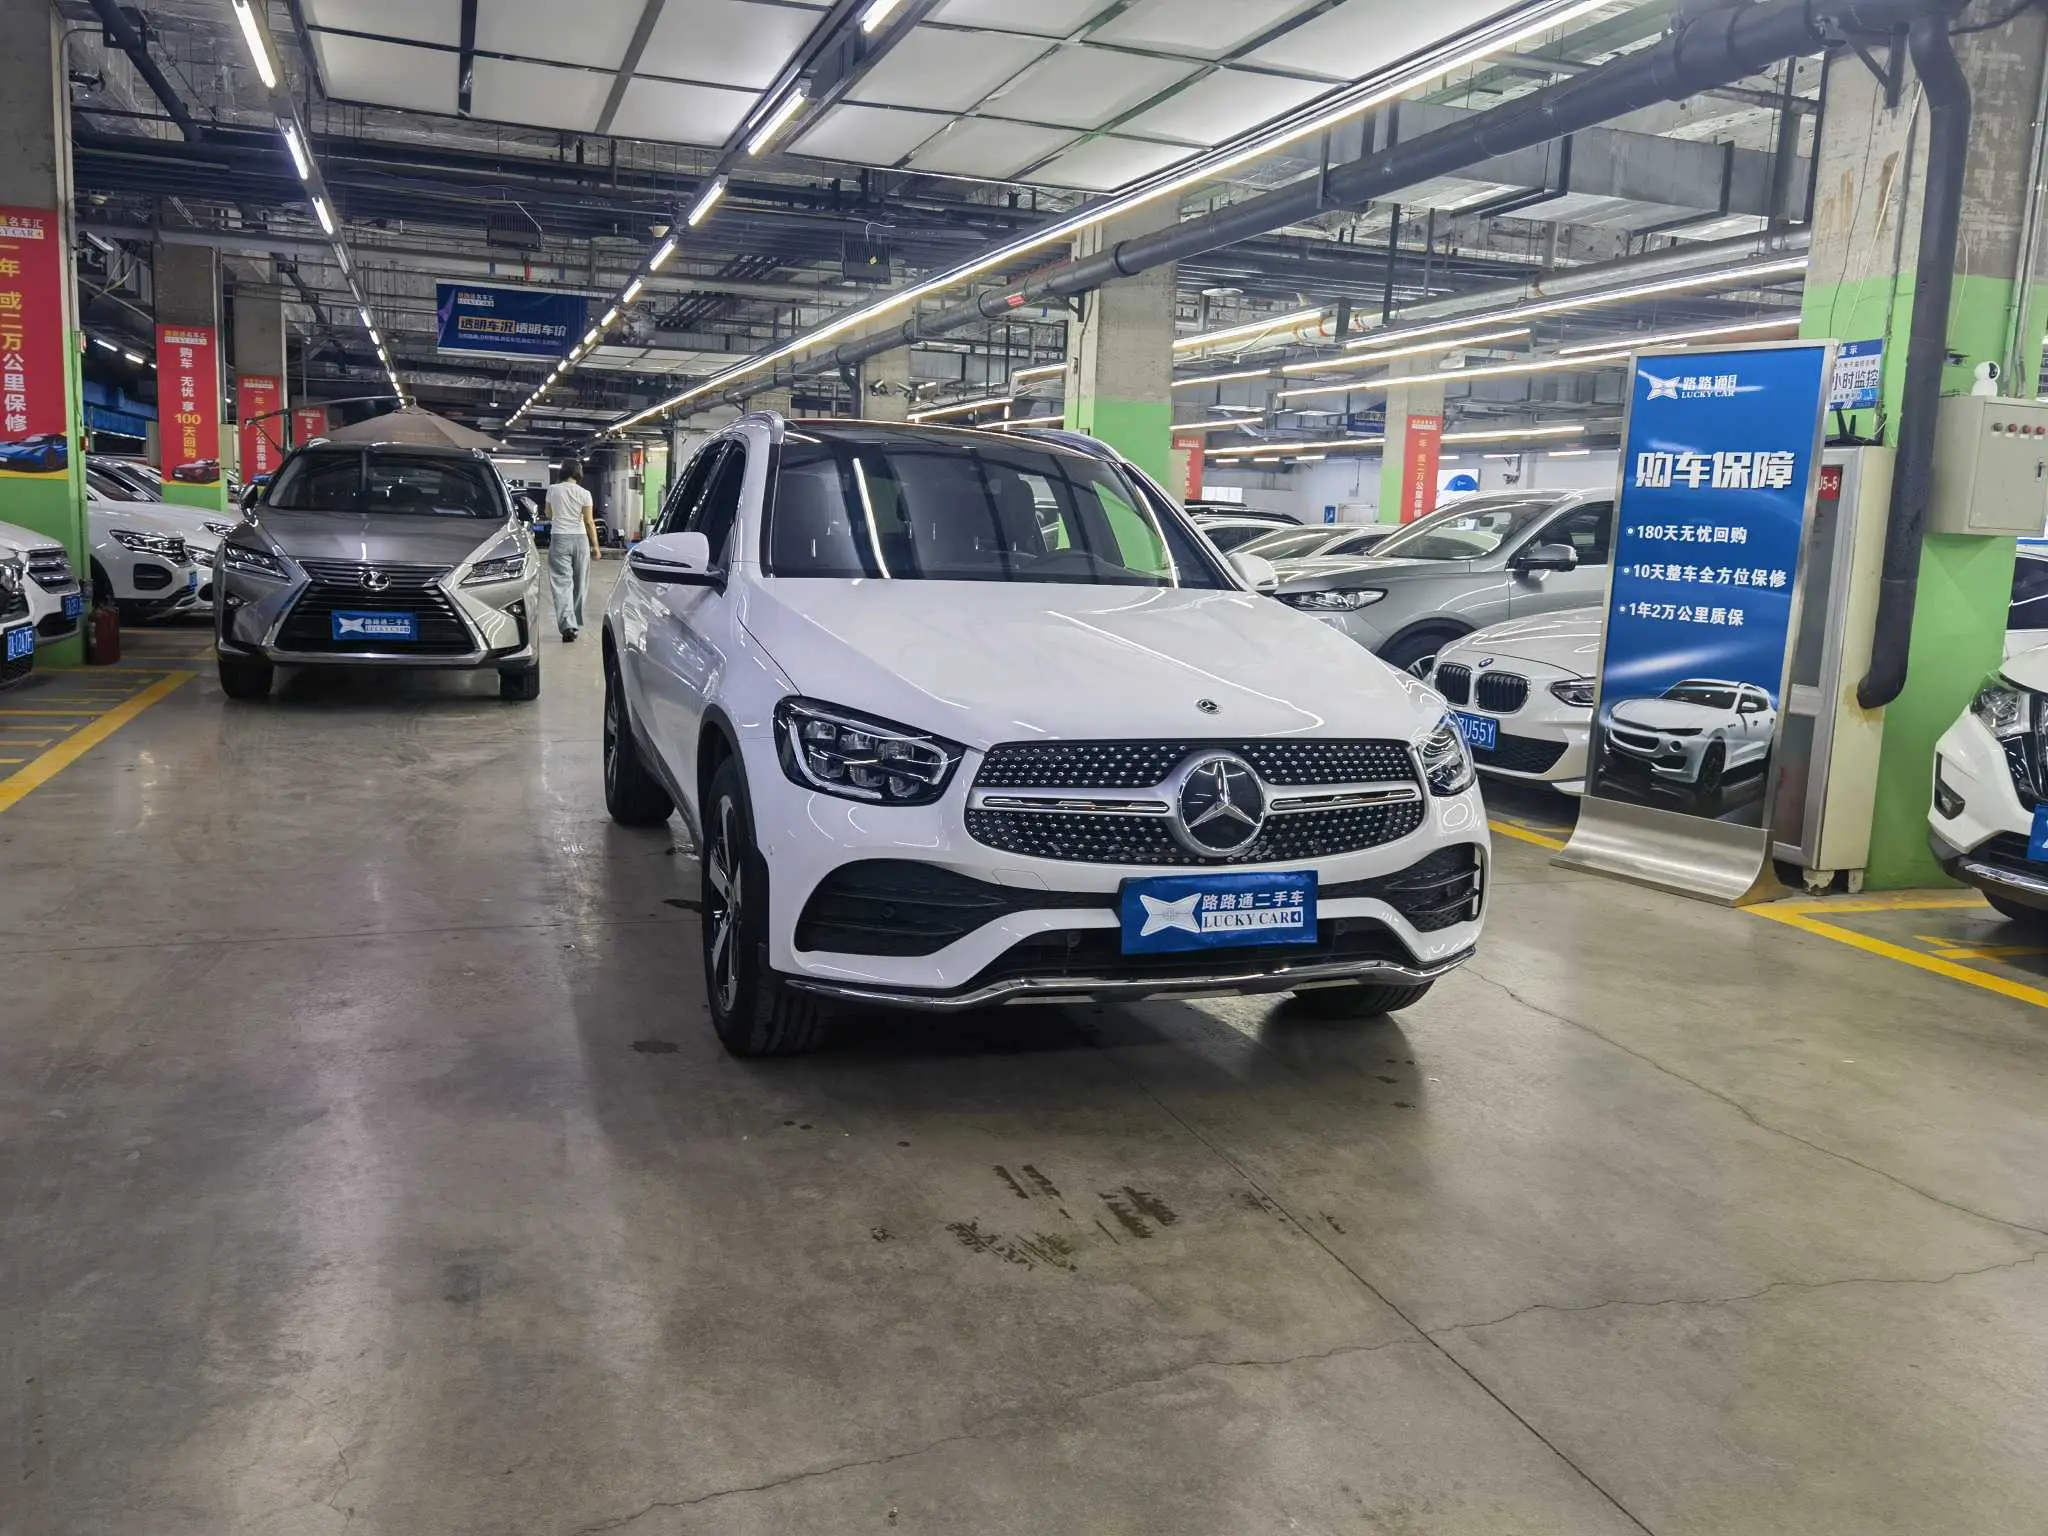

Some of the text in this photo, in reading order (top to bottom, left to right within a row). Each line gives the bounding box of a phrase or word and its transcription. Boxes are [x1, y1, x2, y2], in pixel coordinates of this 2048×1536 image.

[1832, 369, 1879, 391] 小时监控
[1681, 389, 1736, 399] LUCKY CAR
[1635, 450, 1795, 489] 购车保障
[1637, 524, 1748, 544] 180天无忧回购
[1633, 564, 1787, 588] 10天整车全方位保修
[1629, 602, 1745, 626] 1年2万公里质保
[1202, 890, 1305, 910] 路路通二手车
[1203, 911, 1289, 928] LUCKY CAR
